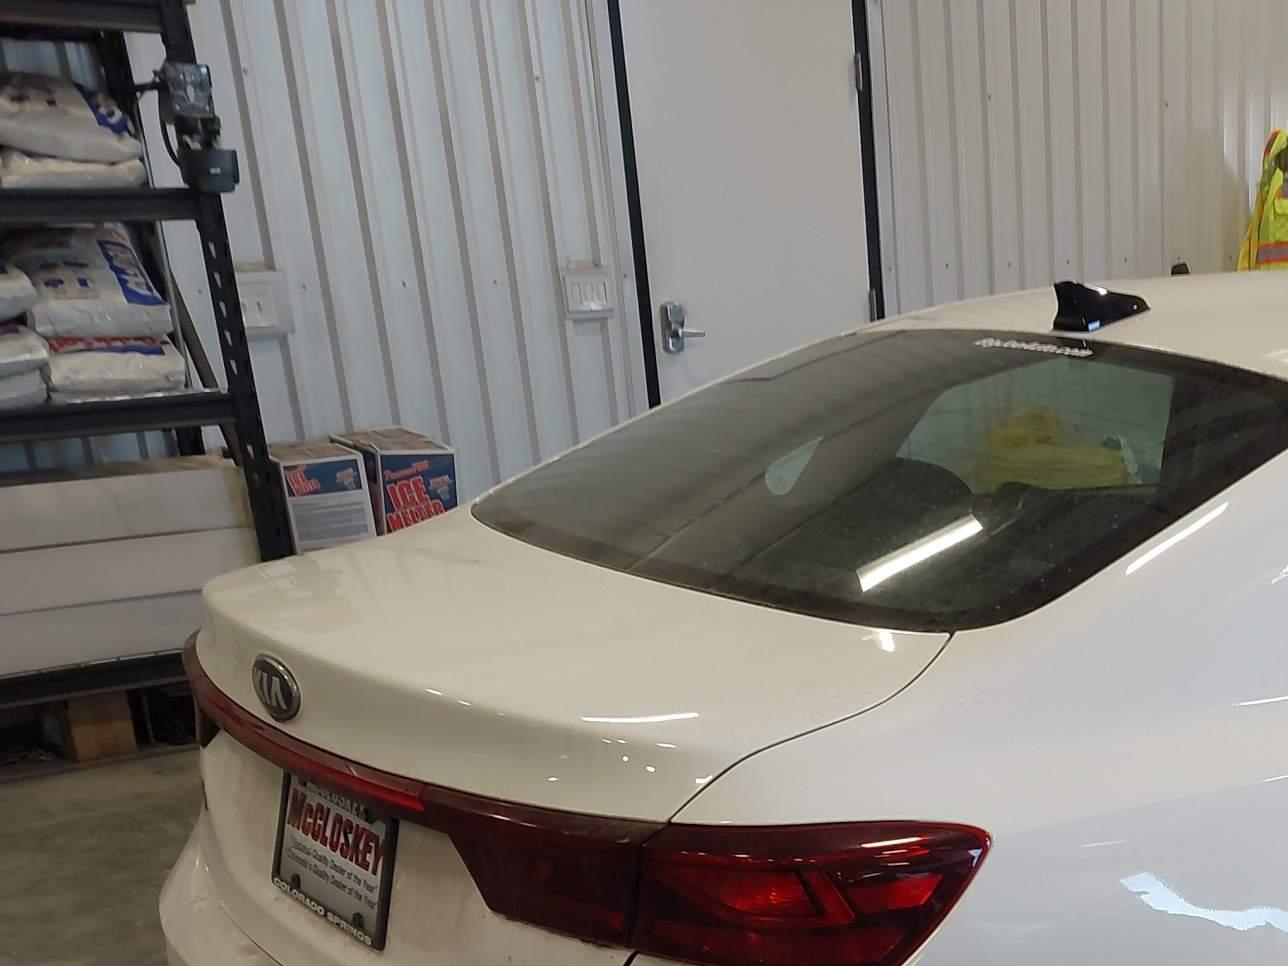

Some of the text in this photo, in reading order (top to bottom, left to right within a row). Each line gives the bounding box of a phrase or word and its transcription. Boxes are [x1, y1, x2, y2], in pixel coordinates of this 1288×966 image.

[387, 475, 428, 512] ICE
[273, 876, 373, 946] COLORADO SPRINGS
